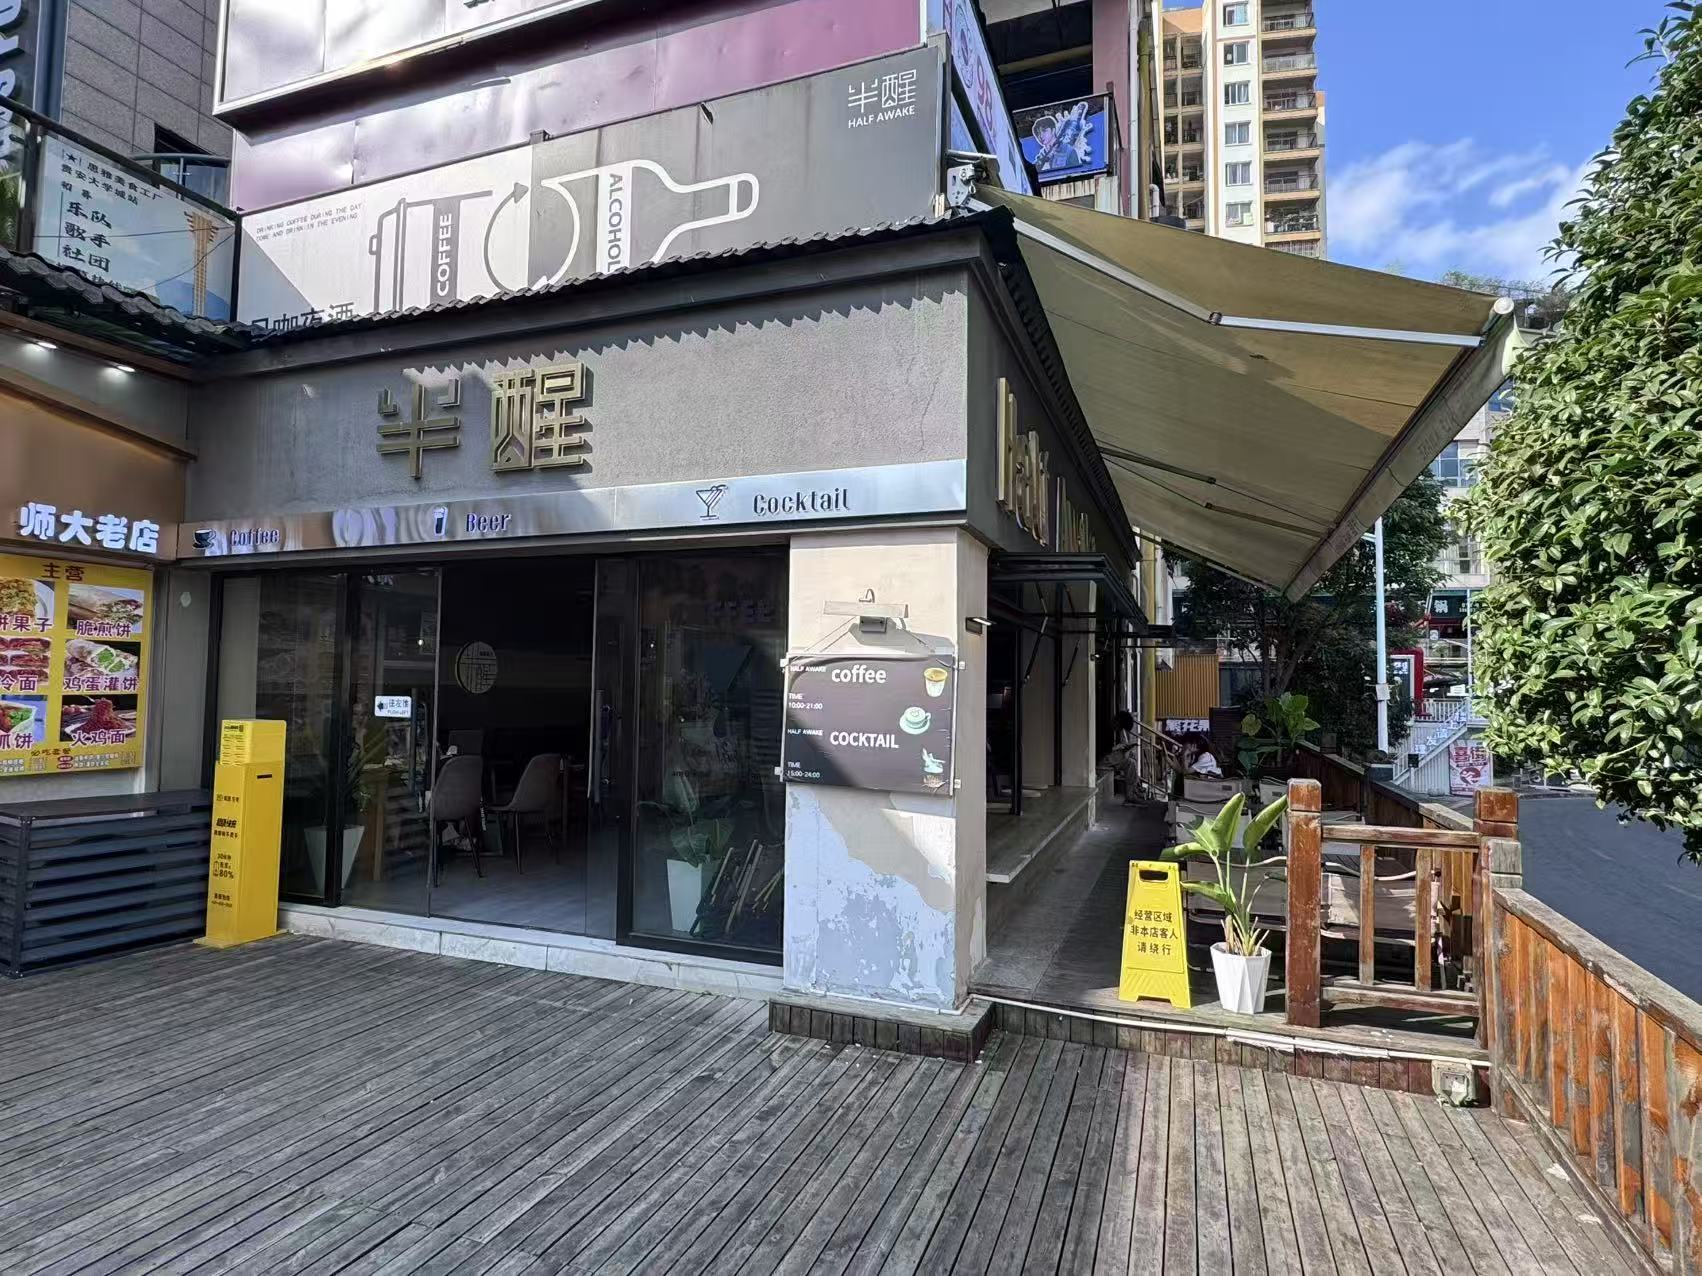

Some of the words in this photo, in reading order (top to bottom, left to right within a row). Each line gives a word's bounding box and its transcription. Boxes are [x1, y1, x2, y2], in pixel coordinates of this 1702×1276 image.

[848, 113, 875, 129] HALF
[876, 104, 915, 123] AWAKE
[67, 201, 112, 229] 乐队
[336, 206, 347, 215] THE
[607, 173, 623, 272] ALCOHOL
[64, 221, 111, 248] 歌手
[62, 244, 111, 272] 社团
[437, 213, 452, 296] COFFEE
[753, 487, 851, 517] Cocktail
[19, 501, 160, 553] 师大老店
[466, 512, 511, 533] Beer
[229, 528, 280, 547] Coffee
[42, 563, 85, 582] 主营
[76, 620, 132, 638] 脆煎饼
[64, 675, 138, 692] 鸡蛋灌饼
[790, 665, 805, 673] HALF
[831, 664, 887, 684] coffee
[788, 702, 823, 710] 10:00-21:00
[71, 729, 126, 747] 火鸡面
[830, 731, 900, 748] COCKTAIL
[1134, 909, 1173, 924] 经营区域
[1130, 924, 1179, 940] 非本店客人
[1137, 941, 1172, 956] 请绕行
